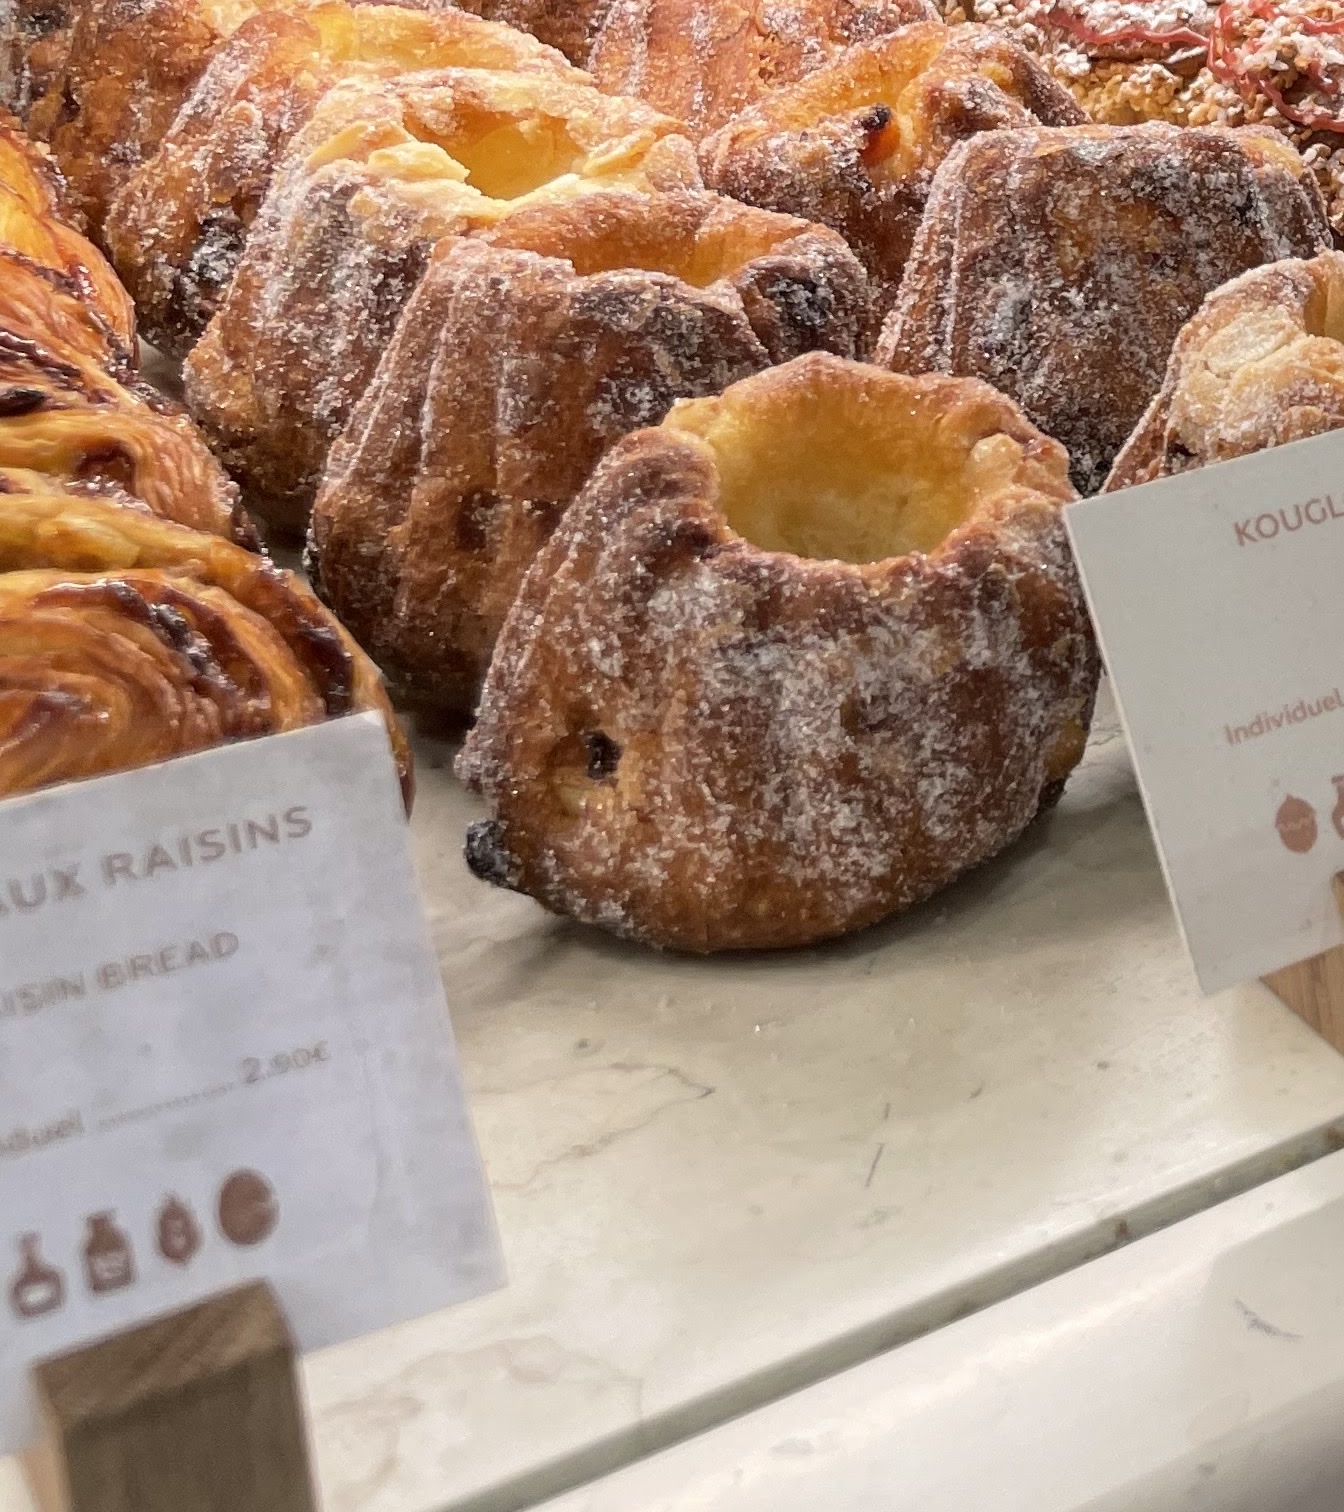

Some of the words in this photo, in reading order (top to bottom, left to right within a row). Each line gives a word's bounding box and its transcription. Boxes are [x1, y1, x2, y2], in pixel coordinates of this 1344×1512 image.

[100, 804, 315, 888] RAISINS
[0, 969, 87, 1019] ISIN
[95, 931, 241, 992] BREAD
